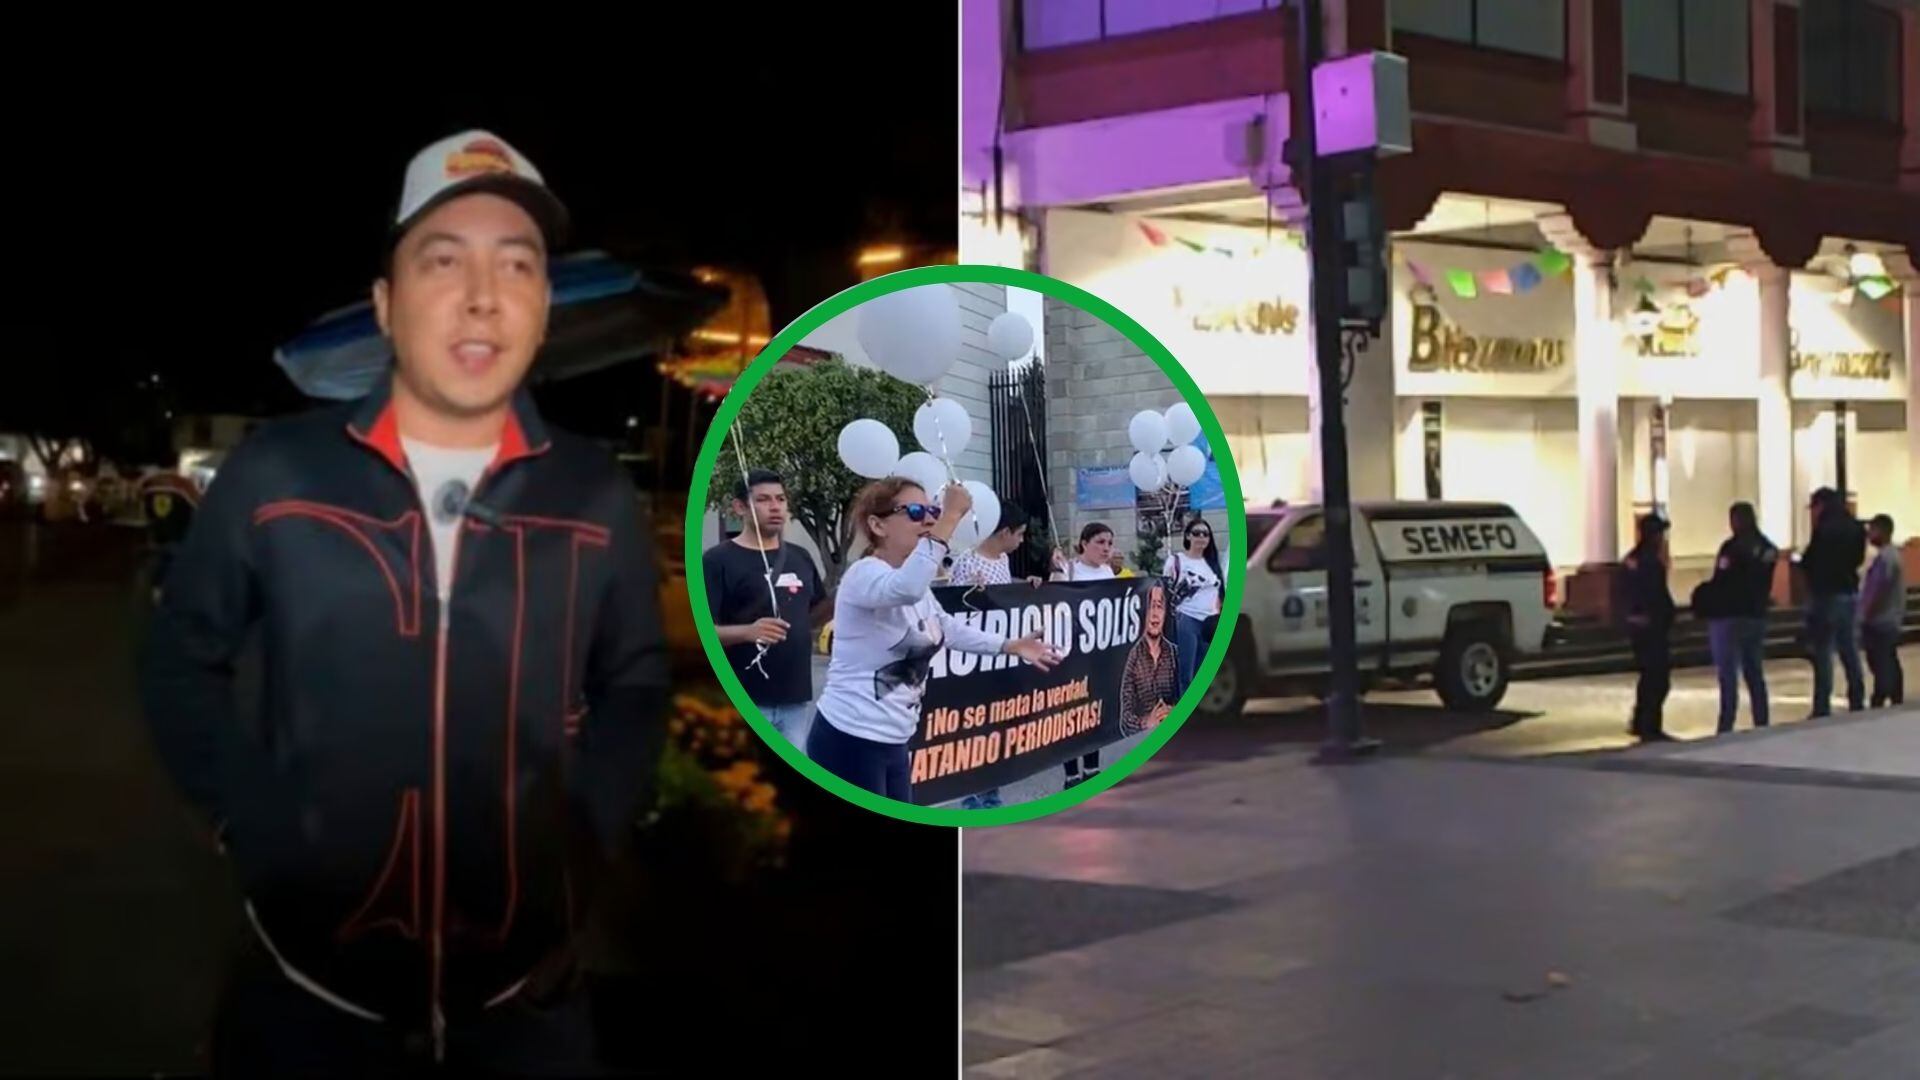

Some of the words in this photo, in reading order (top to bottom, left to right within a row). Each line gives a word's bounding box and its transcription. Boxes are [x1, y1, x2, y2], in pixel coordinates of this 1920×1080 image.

[1402, 523, 1516, 554] SEMEFO
[926, 601, 1072, 678] URICIO
[1079, 587, 1141, 653] SOLÍS
[908, 731, 1001, 784] ATANDO
[1004, 699, 1103, 759] PERIODISTAS!
[925, 707, 959, 741] ¡No
[963, 704, 986, 729] se
[989, 694, 1030, 724] mata
[1032, 688, 1045, 713] la
